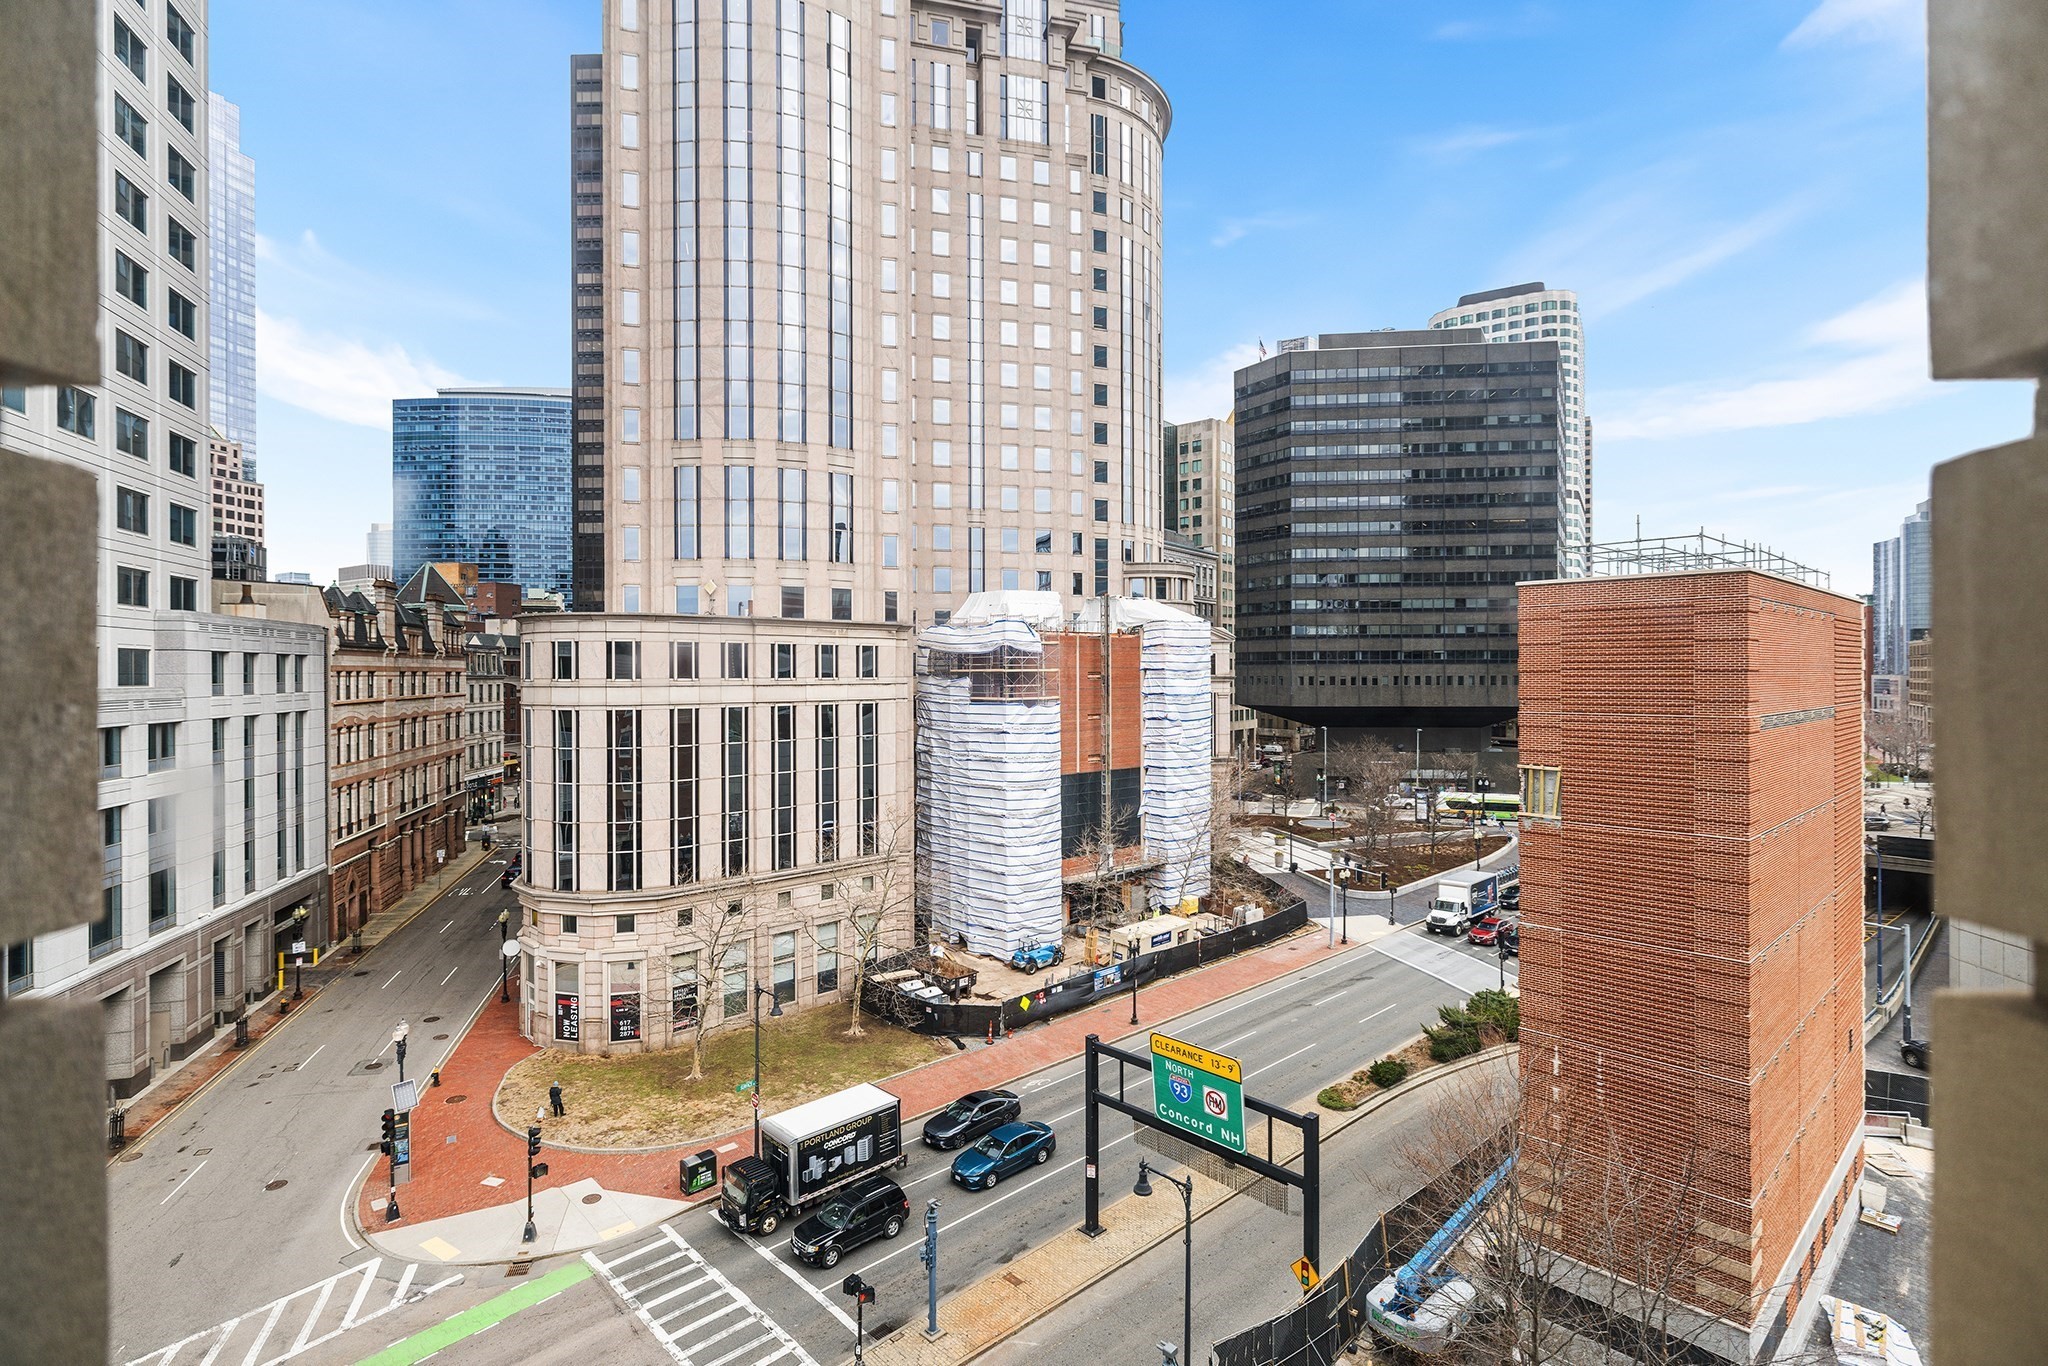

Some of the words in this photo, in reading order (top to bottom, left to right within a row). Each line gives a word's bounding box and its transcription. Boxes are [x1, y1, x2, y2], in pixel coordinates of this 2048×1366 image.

[570, 997, 578, 1038] LEASING
[1155, 1040, 1204, 1064] CLEARANCE
[1165, 1060, 1194, 1079] NORTH
[1173, 1082, 1188, 1098] 93
[804, 1126, 845, 1148] PORTLAND
[846, 1115, 873, 1132] GROUP
[1159, 1104, 1213, 1134] Concord
[1221, 1128, 1240, 1146] NH
[823, 1131, 857, 1150] CONCORD
